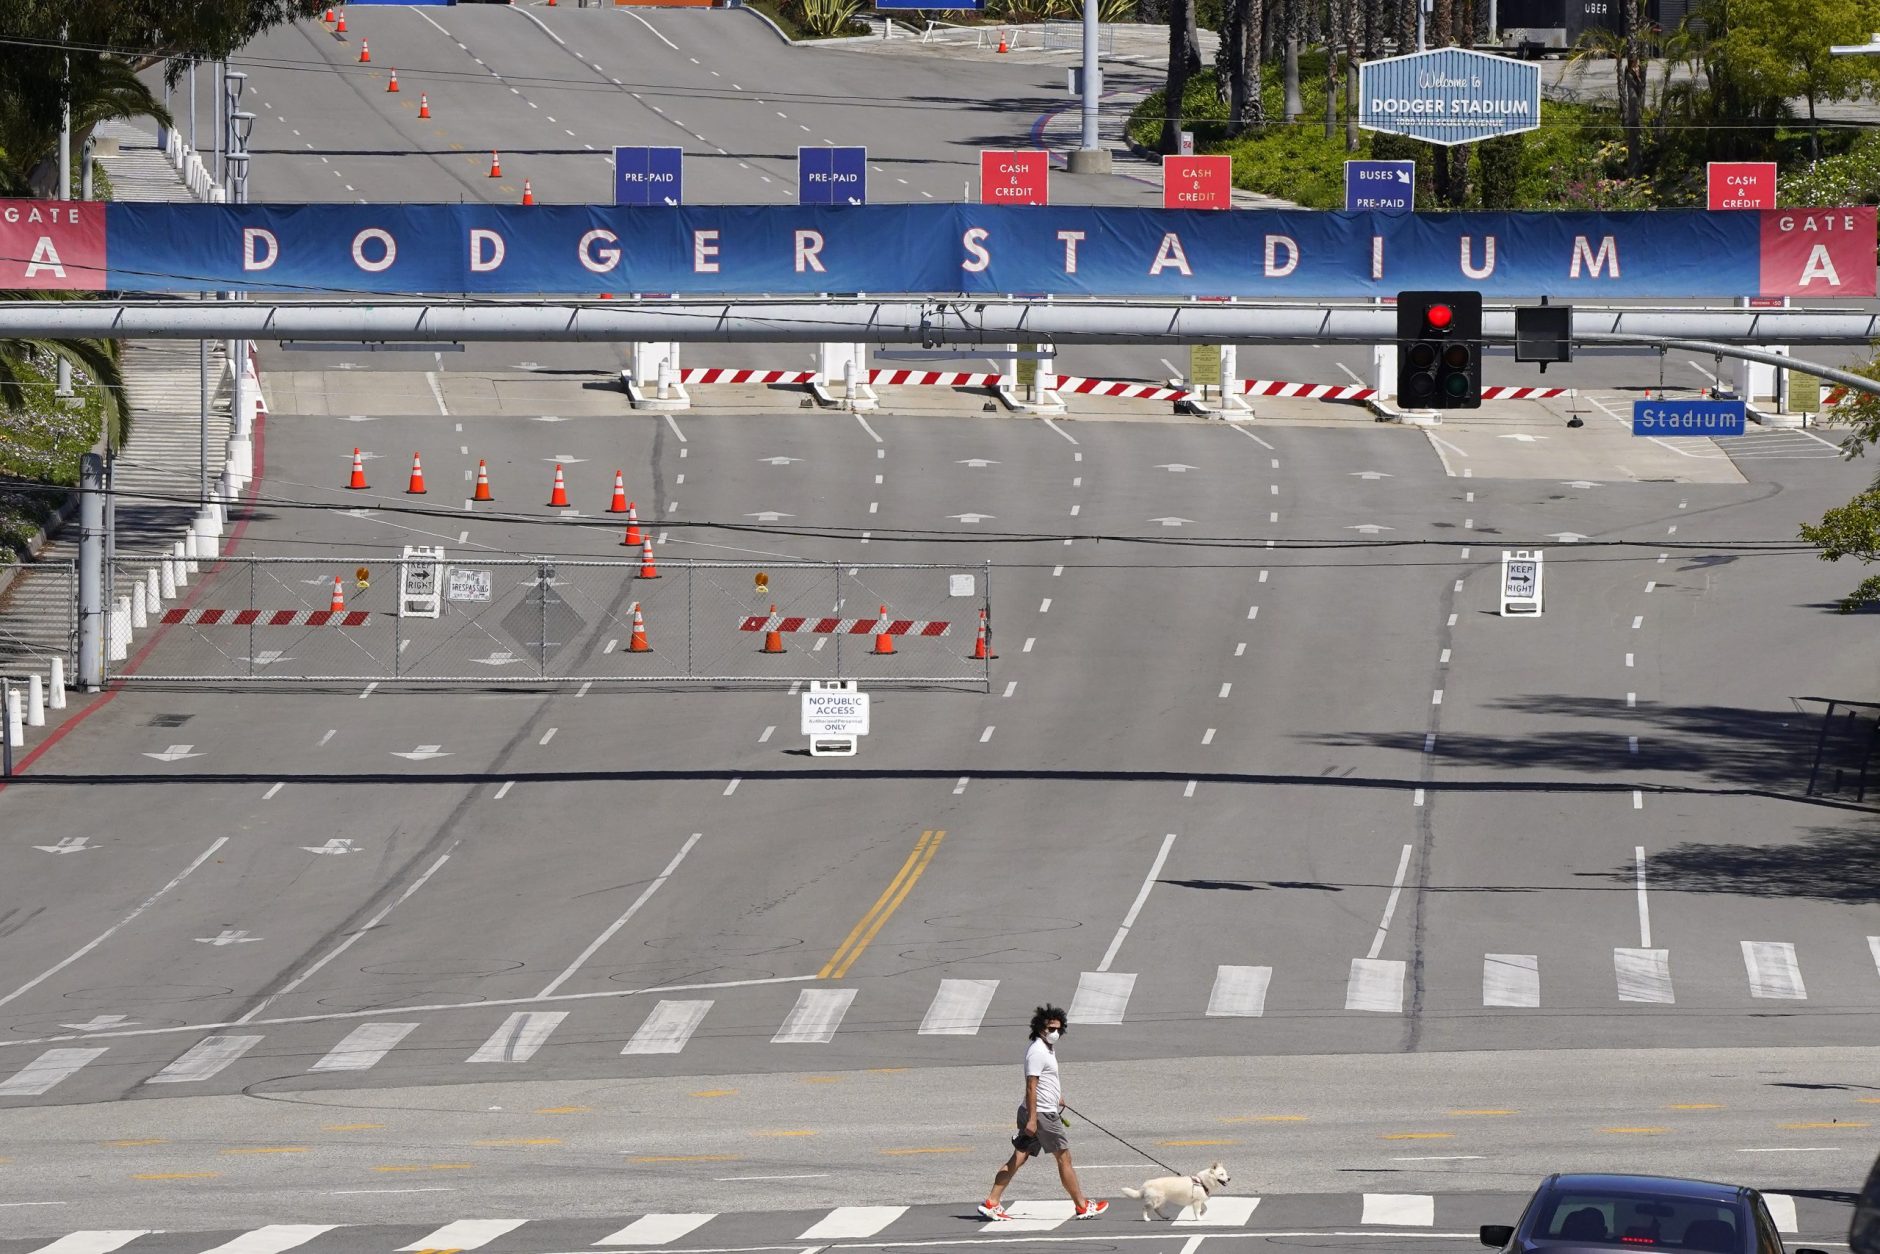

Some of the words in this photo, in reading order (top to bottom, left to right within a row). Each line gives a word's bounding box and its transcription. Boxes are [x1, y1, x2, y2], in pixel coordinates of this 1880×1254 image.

[1584, 3, 1608, 14] UBER
[1419, 69, 1467, 89] Welcome
[1471, 74, 1481, 88] to
[1372, 98, 1444, 113] DODGER
[1451, 99, 1528, 114] STADIUM
[1417, 118, 1434, 126] VIN
[1436, 118, 1467, 127] SCULLY
[1469, 118, 1504, 127] AVENUE
[999, 164, 1029, 173] CASH
[1182, 168, 1212, 178] CASH
[625, 173, 673, 182] PRE-PAID
[808, 173, 857, 183] PRE-PAID
[1360, 170, 1393, 180] BUSES
[1010, 176, 1018, 185] &
[1193, 180, 1200, 190] &
[1727, 176, 1757, 185] CASH
[995, 187, 1033, 197] CREDIT
[1178, 192, 1215, 202] CREDIT
[1738, 188, 1745, 196] &
[1357, 198, 1405, 208] PRE-PAID
[1722, 200, 1761, 208] CREDIT
[4, 207, 79, 223] GATE
[1779, 215, 1854, 231] GATE
[24, 236, 67, 279] A
[242, 227, 829, 275] DODGER
[961, 228, 1622, 281] STADIUM
[1798, 244, 1841, 287] A
[1642, 409, 1736, 428] Stadium
[1510, 565, 1533, 573] KEEP
[466, 573, 475, 581] NO
[408, 581, 433, 589] RIGHT
[452, 583, 489, 593] TRESPASSING
[1507, 585, 1533, 593] RIGHT
[809, 697, 826, 705] NO
[827, 697, 862, 706] PUBLIC
[816, 706, 855, 715] ACCESS
